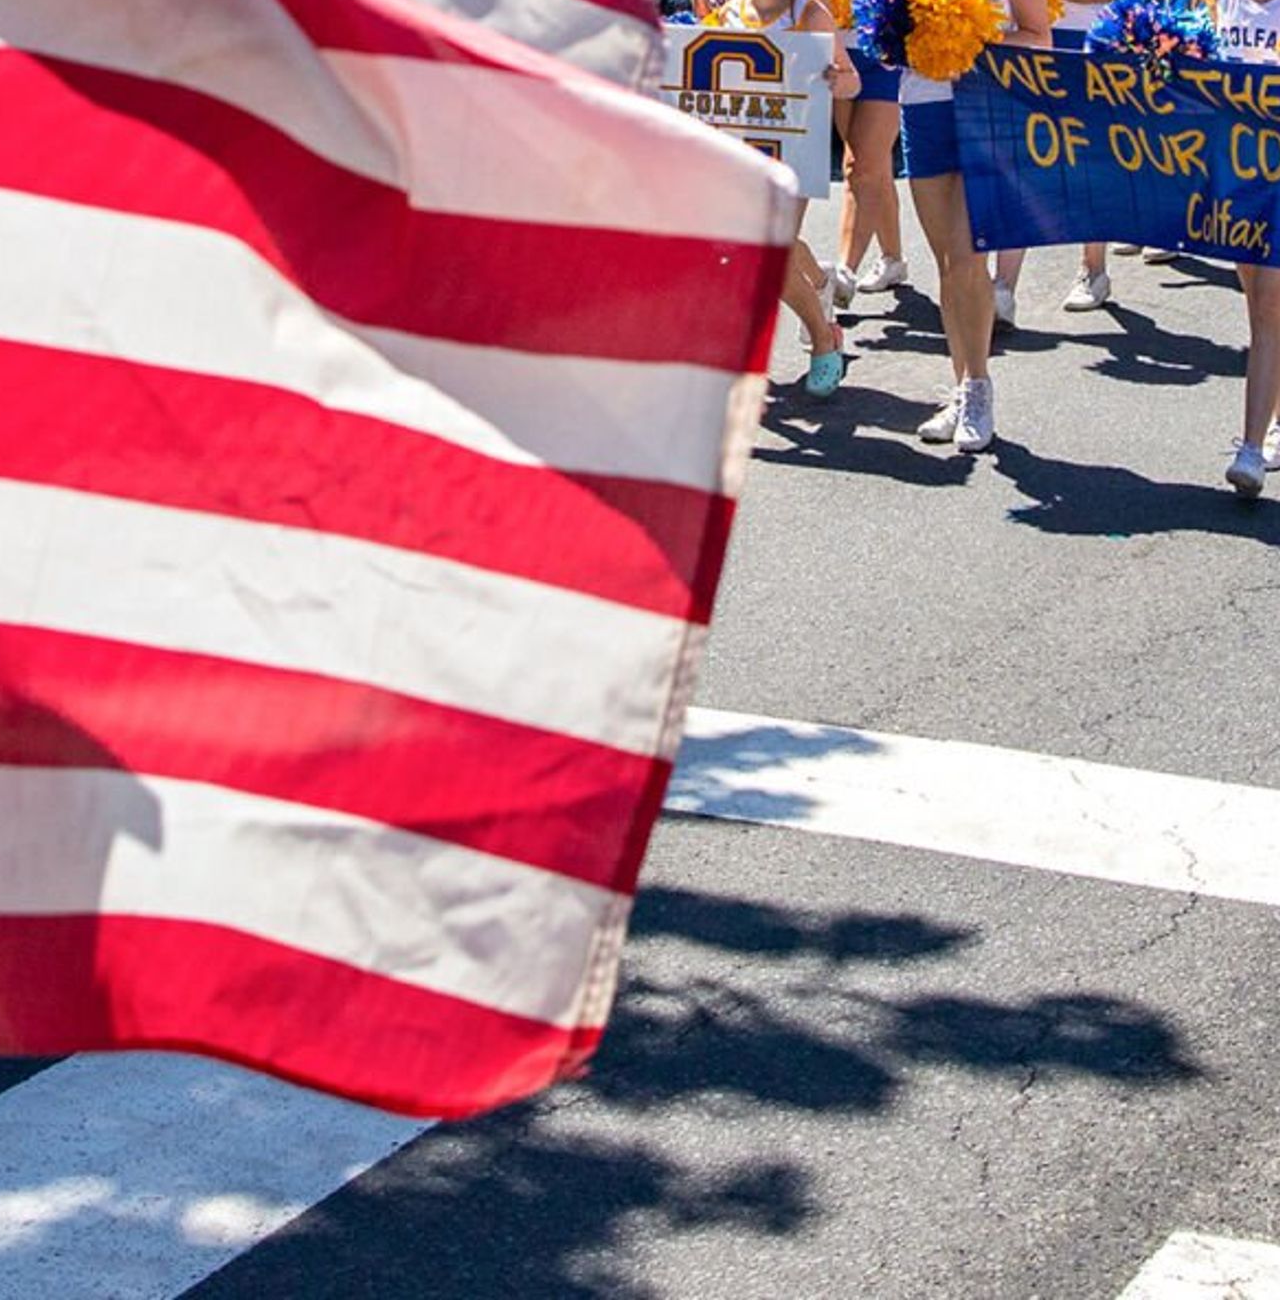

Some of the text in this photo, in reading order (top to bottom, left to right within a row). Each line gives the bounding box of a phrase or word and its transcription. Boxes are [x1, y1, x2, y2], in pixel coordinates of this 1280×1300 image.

[679, 91, 787, 120] COLFAX
[986, 50, 1067, 98] WE
[1085, 59, 1176, 115] ARE
[1025, 111, 1090, 167] OF
[1108, 123, 1209, 178] OUR
[1186, 192, 1269, 258] Colfax,
